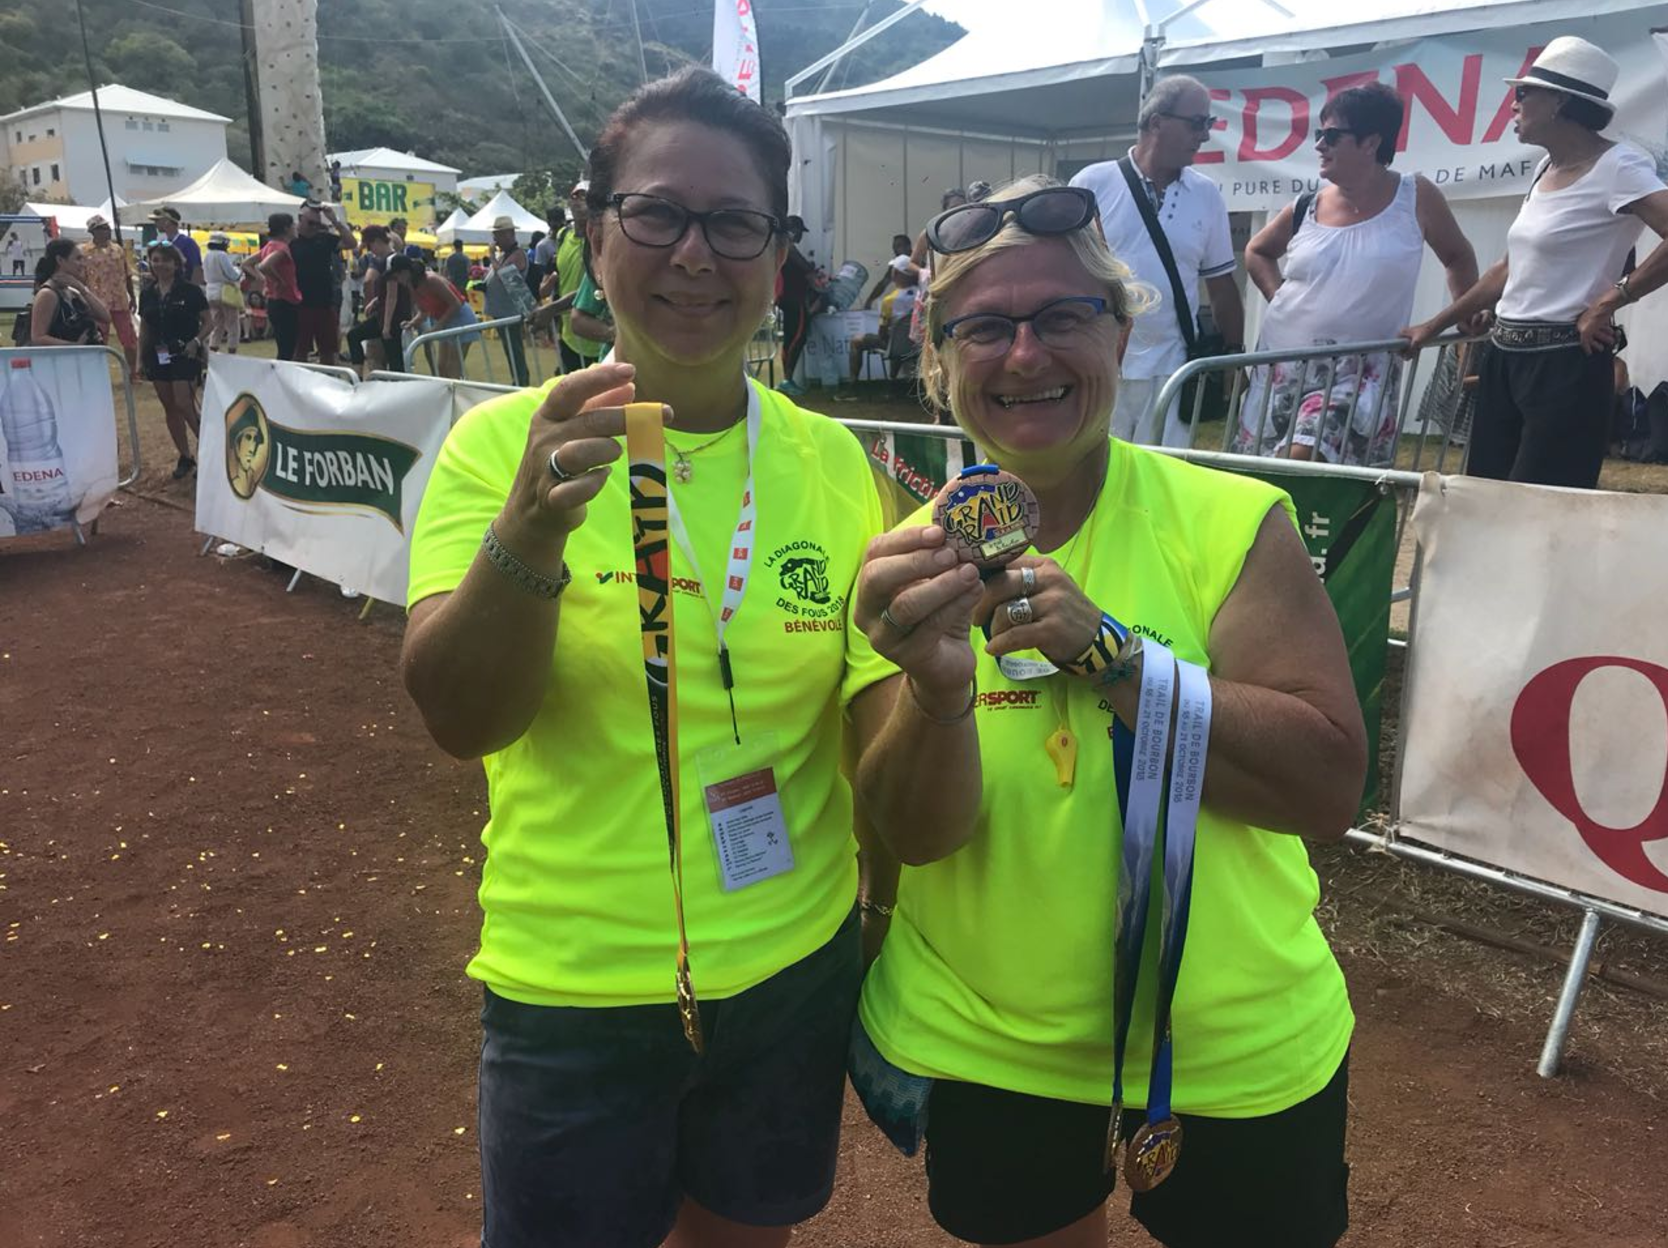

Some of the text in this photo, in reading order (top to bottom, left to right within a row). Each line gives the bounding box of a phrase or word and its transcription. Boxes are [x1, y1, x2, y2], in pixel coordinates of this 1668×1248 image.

[1193, 46, 1548, 164] EDN
[1233, 180, 1281, 196] PURE
[1291, 179, 1320, 193] DU
[1435, 167, 1465, 184] DE
[1479, 160, 1532, 180] MAF
[358, 181, 408, 212] BAR
[871, 438, 889, 464] La
[13, 467, 63, 482] EDENA
[275, 442, 394, 495] LE FORBAN
[764, 556, 776, 568] LA
[776, 597, 799, 614] DES
[801, 607, 828, 617] FOUS
[1147, 678, 1169, 780] TRAIL DE BOURBON
[1185, 701, 1205, 801] TRAIL DE BOURBON
